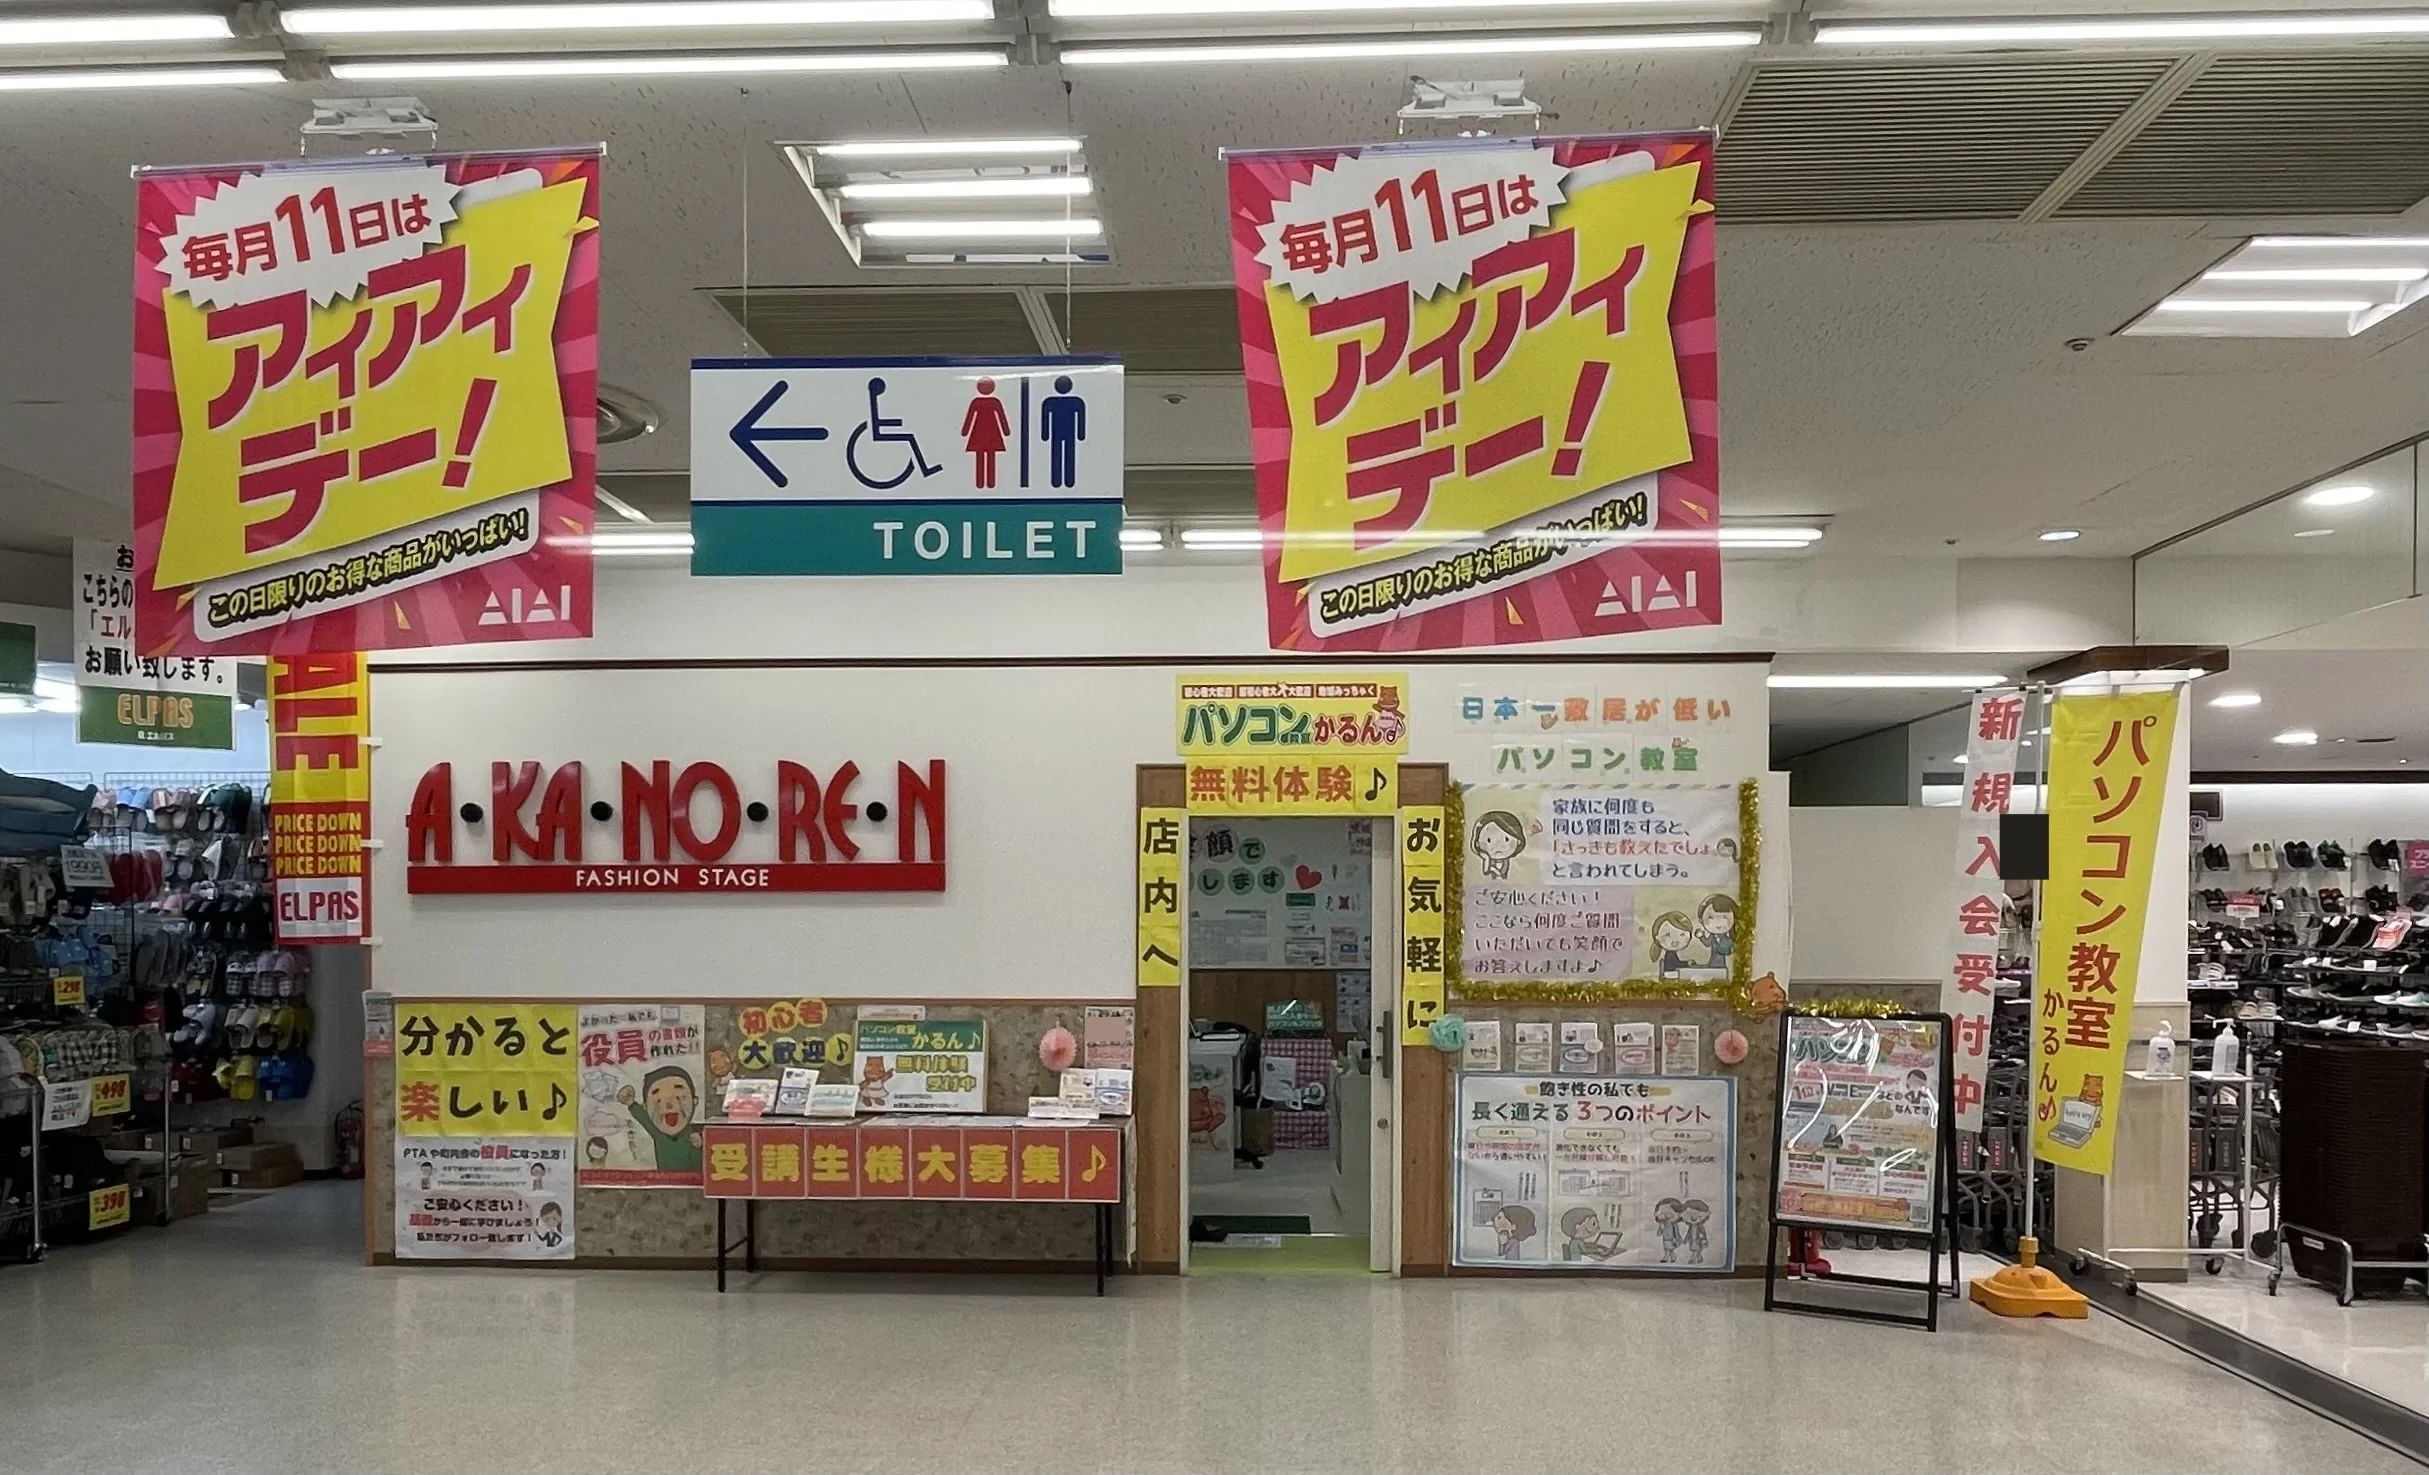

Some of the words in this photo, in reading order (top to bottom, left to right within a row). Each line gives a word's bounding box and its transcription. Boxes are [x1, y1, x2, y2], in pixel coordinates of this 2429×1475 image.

[181, 185, 432, 282] 毎月11日は
[1281, 168, 1539, 275] 毎月11日は
[873, 521, 1096, 559] TOILET
[208, 508, 530, 627] この日限りのお得な商品がいっぱい！
[1182, 702, 1312, 745] パソコン
[275, 813, 314, 833] PRICE
[317, 812, 361, 832] DOWN
[1552, 797, 1655, 815] 家族に何度も
[275, 834, 314, 854] PRICE
[317, 833, 361, 853] DOWN
[1552, 818, 1691, 837] 同じ質問をすると、
[276, 856, 314, 875] PRICE
[318, 854, 361, 874] DOWN
[576, 869, 680, 888] FASHION
[698, 869, 770, 888] STAGE
[1552, 862, 1689, 879] と言われてしまう。
[1142, 817, 1179, 968] 店内へ
[2064, 714, 2158, 1051] パソコン教室
[280, 890, 359, 921] ELPAS
[1475, 911, 1620, 929] ここなら何度ご質問
[1406, 817, 1442, 1030] お気軽に
[400, 1015, 571, 1057] 分かると
[580, 1029, 648, 1067] 役員
[1540, 1081, 1650, 1098] 飽き性の私でも
